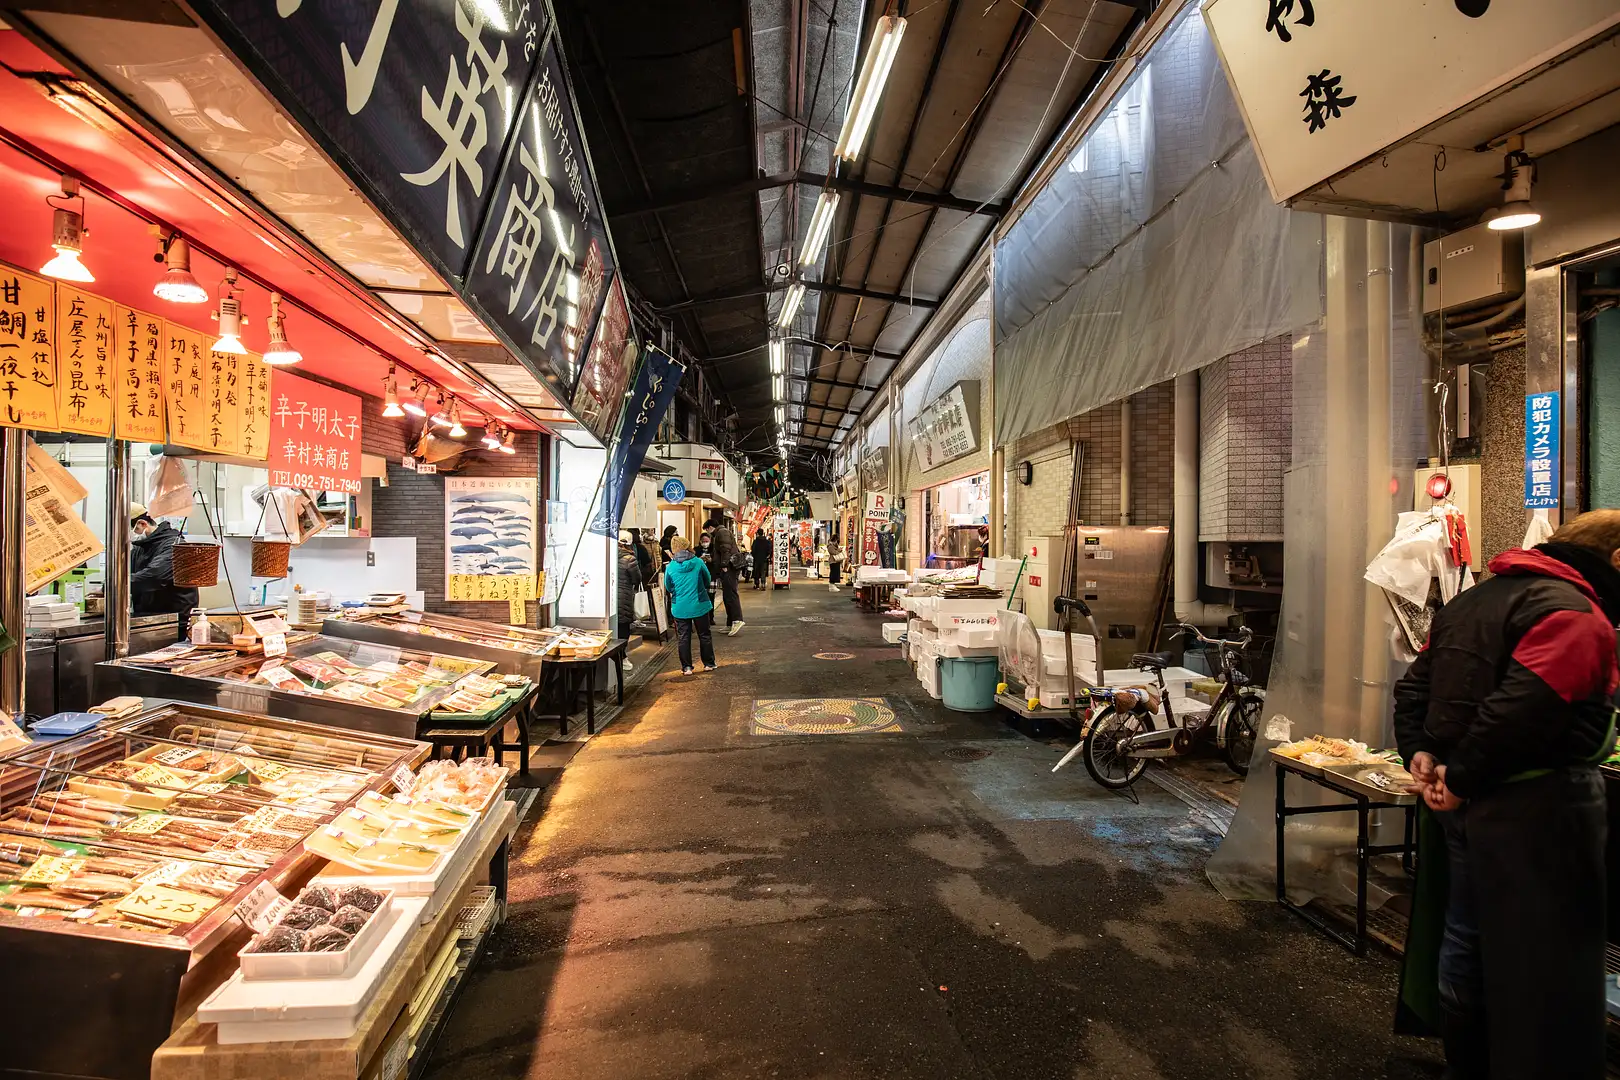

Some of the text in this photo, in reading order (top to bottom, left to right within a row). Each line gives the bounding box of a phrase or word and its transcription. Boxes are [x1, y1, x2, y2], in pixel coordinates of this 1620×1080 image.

[0, 277, 27, 423] 甘鯛一夜干し
[31, 306, 54, 388] 甘塩仕込
[68, 296, 89, 417] 庄屋さんの昆布
[126, 310, 143, 419] 辛子高菜
[189, 343, 201, 398] 家庭用
[170, 337, 186, 434] 切子明太子
[244, 360, 257, 455] 辛子明太子
[274, 393, 360, 441] 辛子明太子
[283, 438, 350, 471] 幸村英商店
[1531, 397, 1552, 497] 防犯カメラ設置店
[868, 509, 889, 518] POINT
[875, 495, 885, 508] R
[1524, 497, 1558, 506] にしけい
[779, 532, 788, 577] ぜんざい祭り
